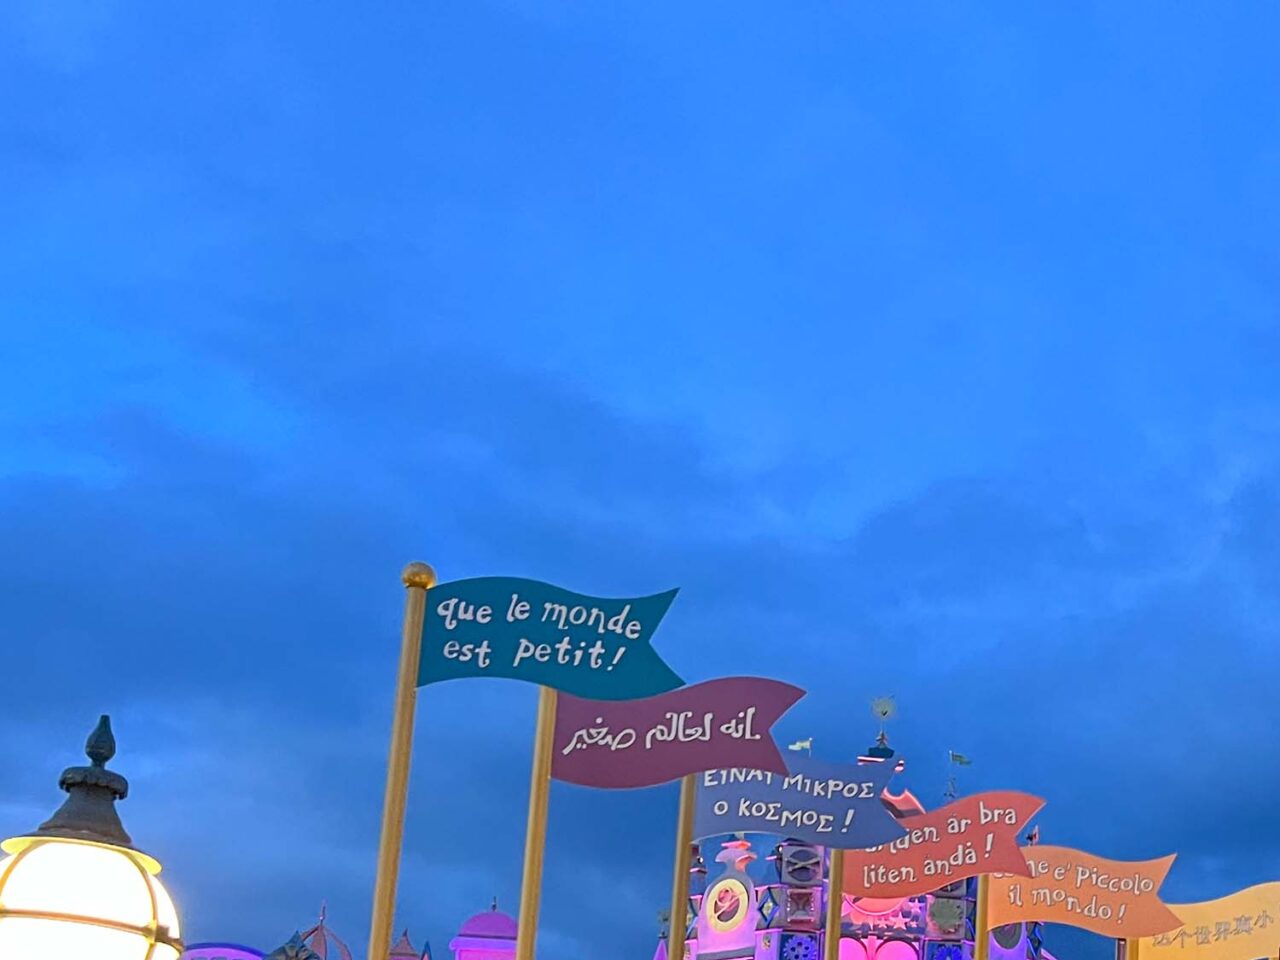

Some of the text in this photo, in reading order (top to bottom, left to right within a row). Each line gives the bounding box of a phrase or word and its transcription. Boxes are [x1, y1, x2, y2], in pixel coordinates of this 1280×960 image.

[436, 593, 642, 640] que le monde
[443, 636, 626, 672] est petit!
[562, 716, 637, 756] صغير
[979, 800, 1017, 826] bra
[863, 862, 917, 888] liten
[1009, 884, 1126, 924] il mondo!
